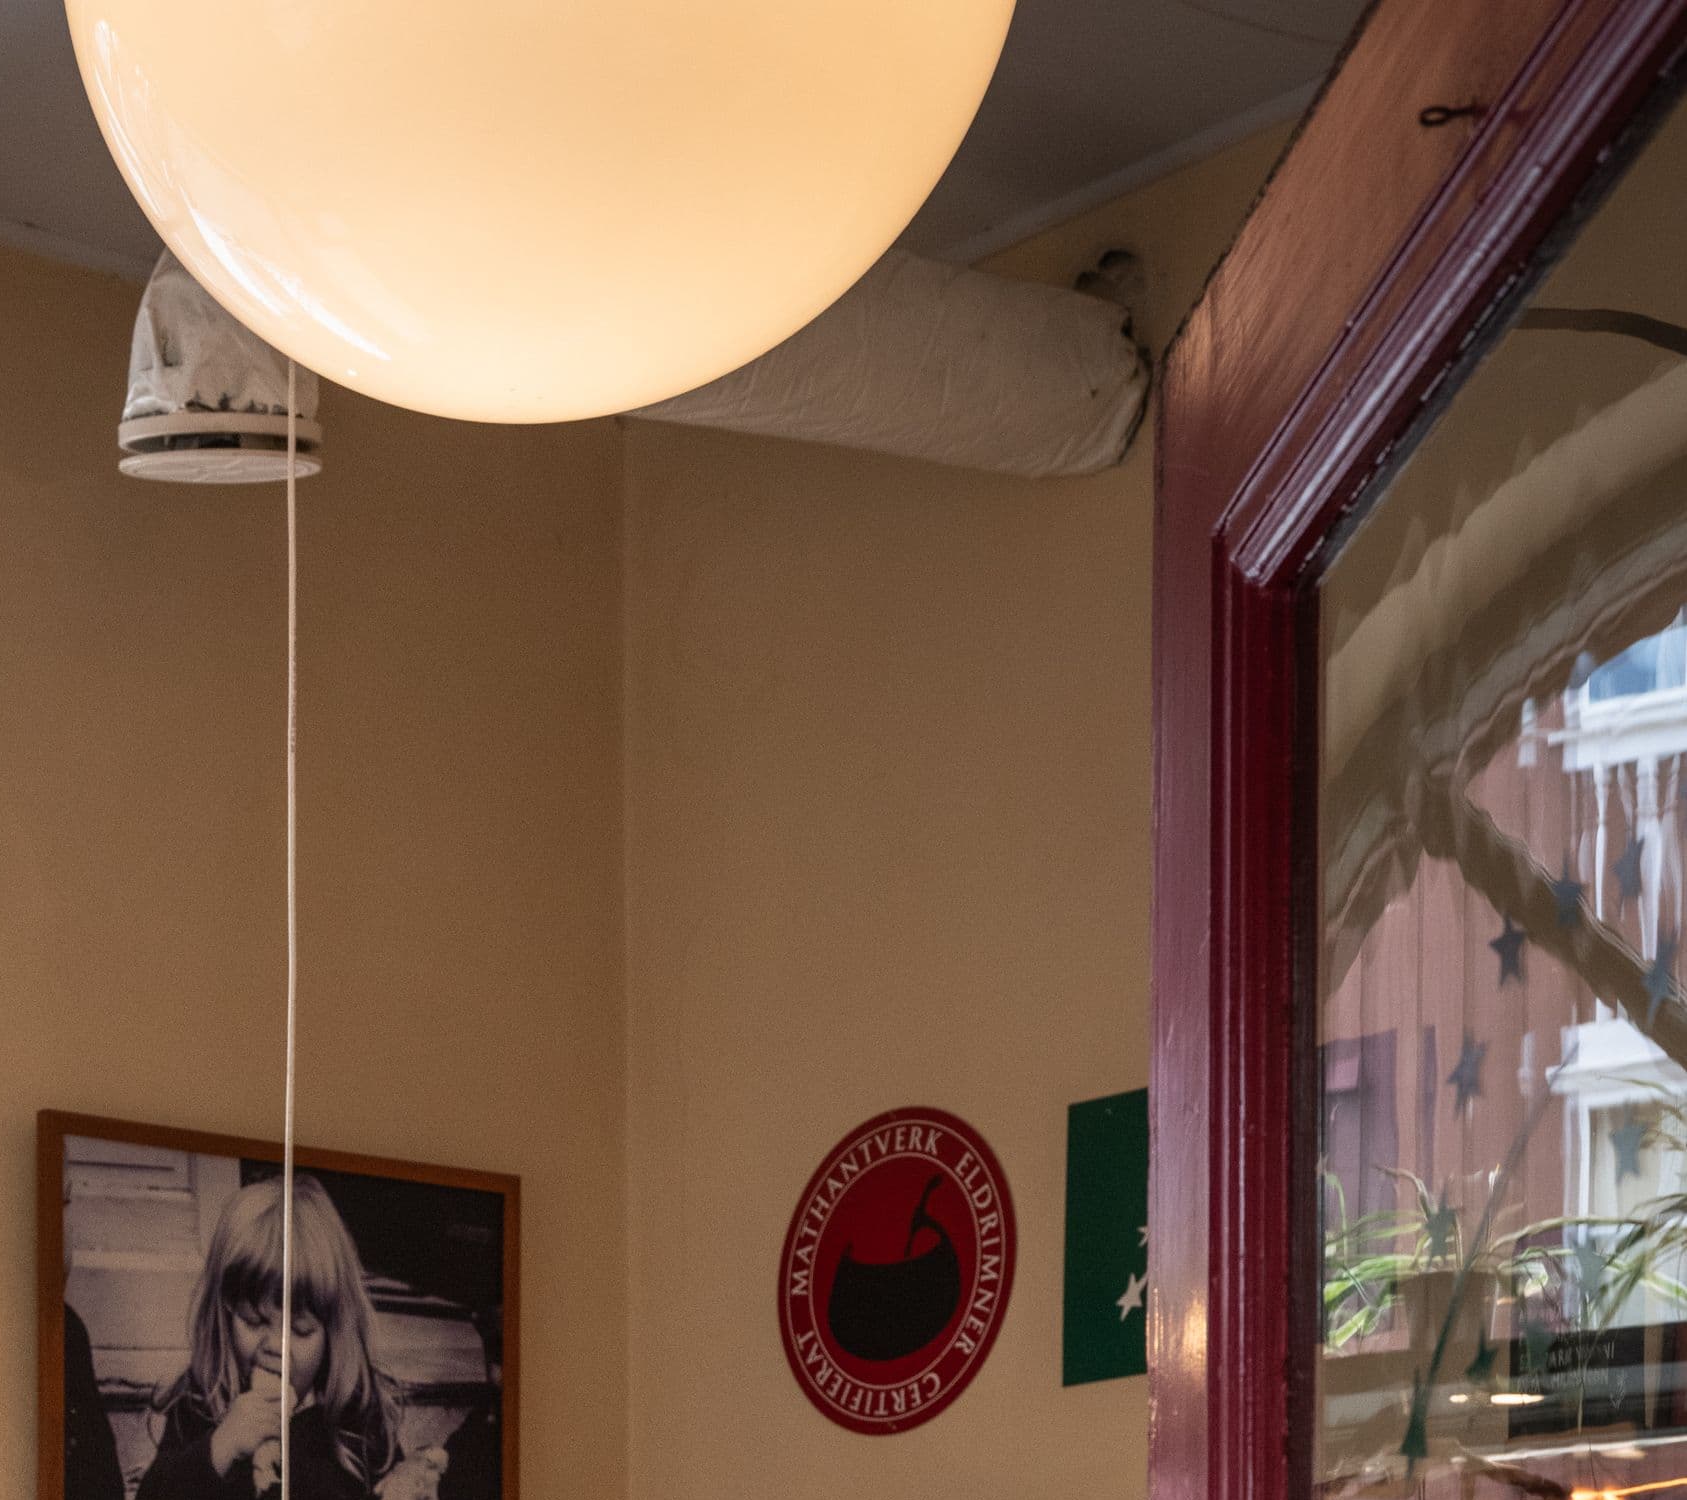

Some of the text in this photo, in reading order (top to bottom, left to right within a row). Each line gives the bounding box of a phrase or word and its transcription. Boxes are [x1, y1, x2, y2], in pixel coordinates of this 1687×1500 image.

[791, 1124, 1000, 1356] MATHANTVERK ELDRIMNER
[795, 1330, 942, 1417] CERTIFIERAT
